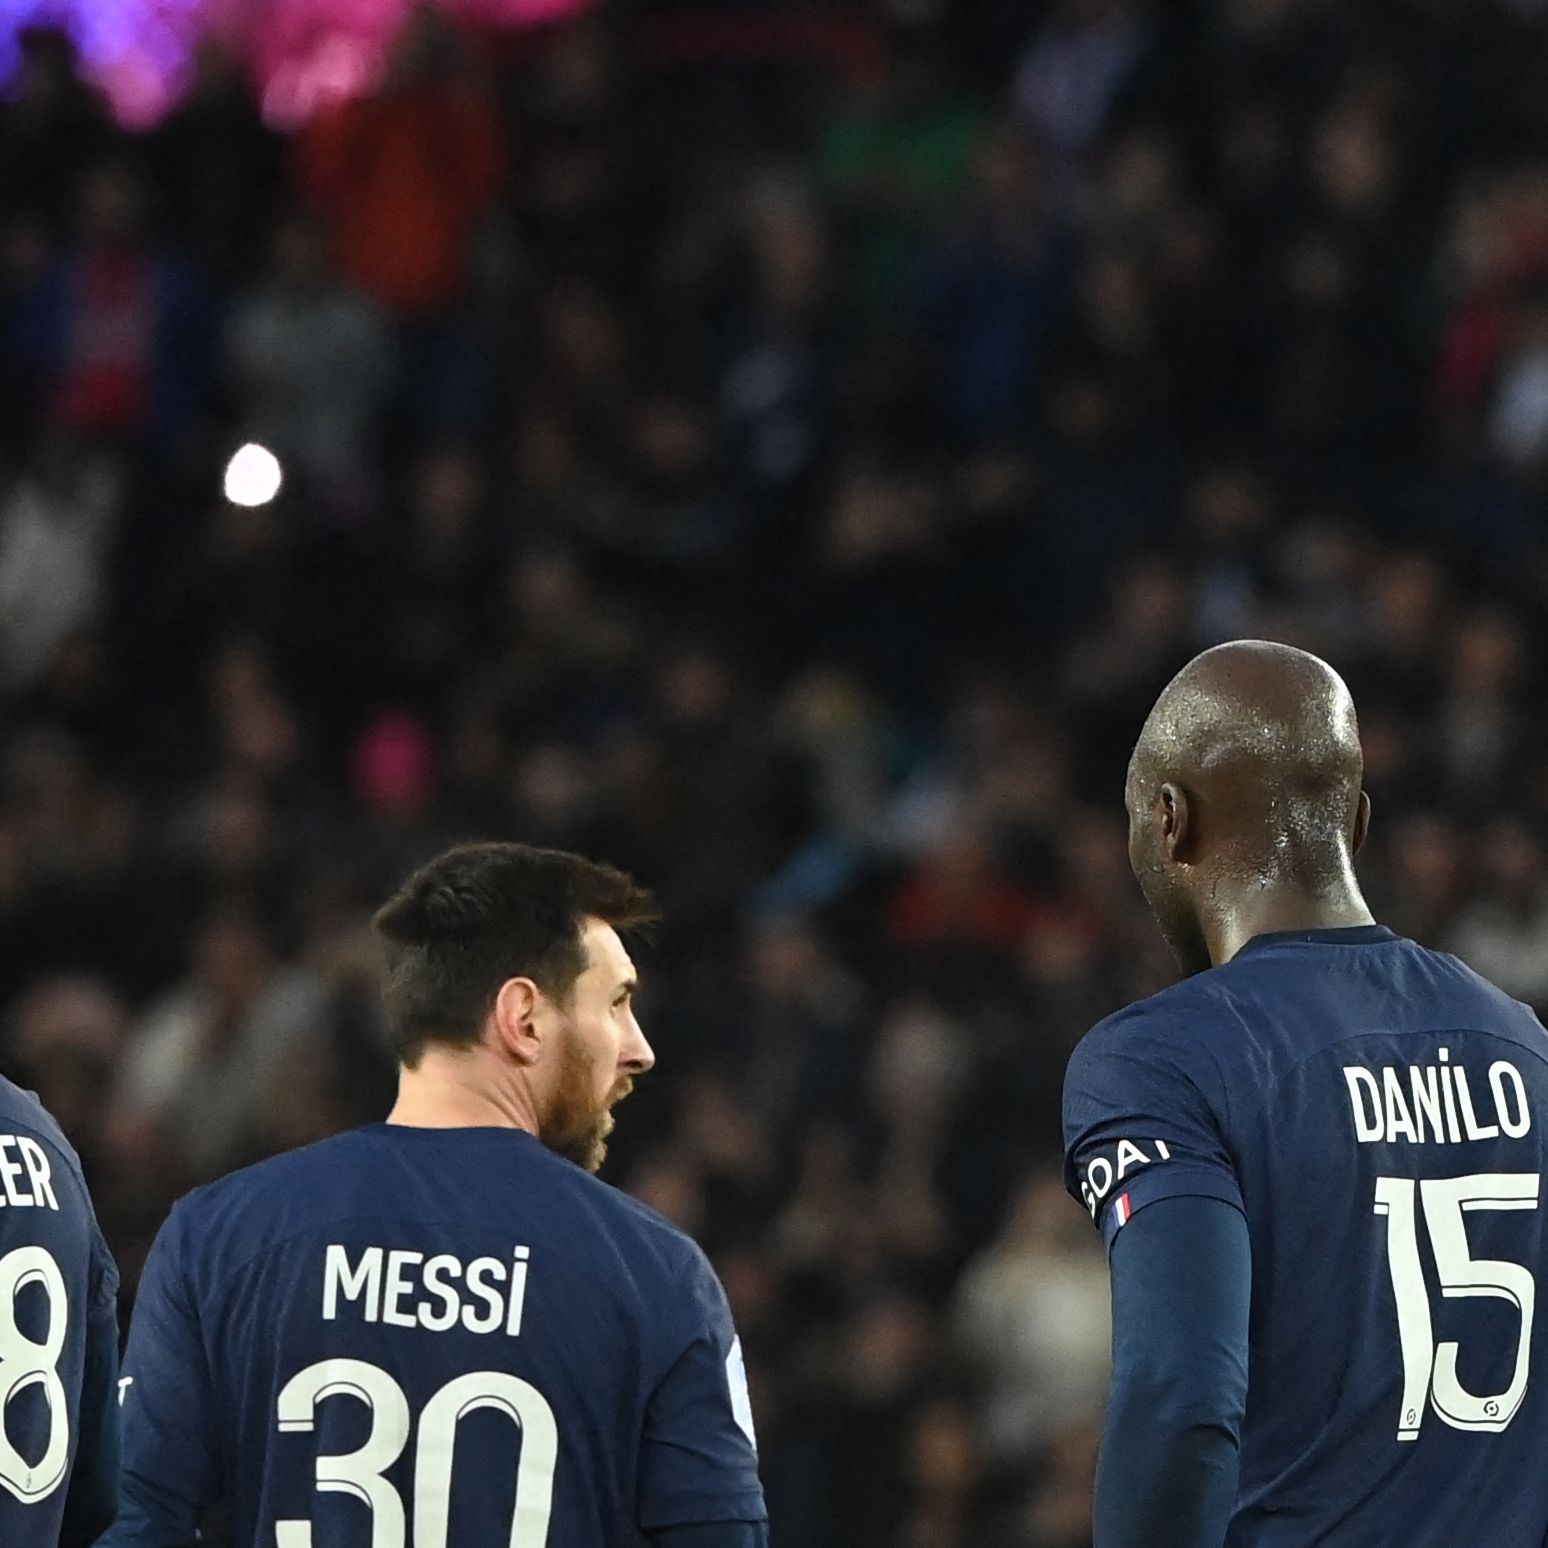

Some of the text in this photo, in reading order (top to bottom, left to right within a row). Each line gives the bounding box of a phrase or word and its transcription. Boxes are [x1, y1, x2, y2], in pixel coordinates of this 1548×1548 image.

[1343, 1047, 1531, 1144] DANILO
[0, 1135, 59, 1211] ER
[322, 1245, 530, 1337] MESSI
[1374, 1173, 1540, 1442] 15
